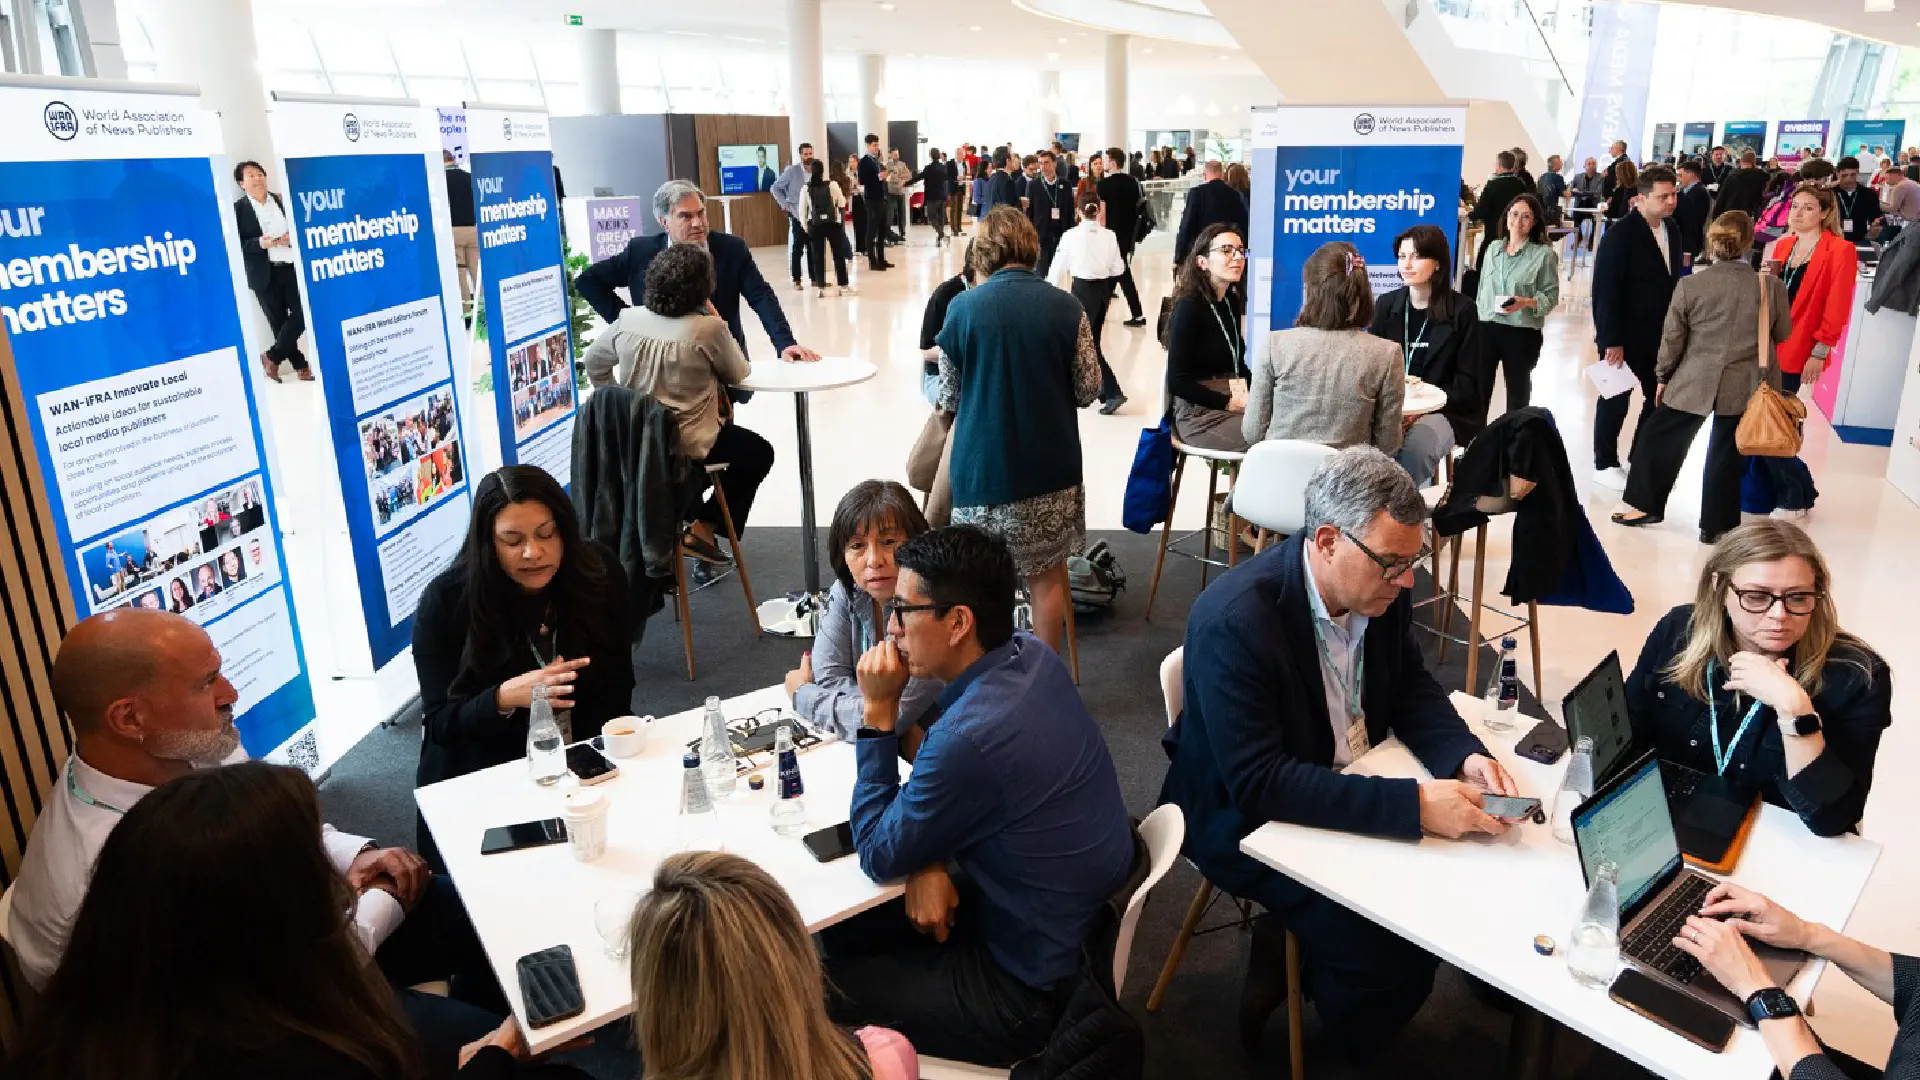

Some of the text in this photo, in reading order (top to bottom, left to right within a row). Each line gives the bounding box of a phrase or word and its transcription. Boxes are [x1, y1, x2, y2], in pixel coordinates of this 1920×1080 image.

[48, 111, 71, 121] WAN
[82, 109, 184, 122] World Association
[86, 124, 192, 136] of News Publishers
[477, 176, 504, 203] your
[1285, 168, 1340, 192] your
[298, 188, 346, 222] your
[480, 192, 547, 224] membership
[593, 206, 630, 220] MAKE
[1284, 188, 1435, 217] membership
[305, 207, 419, 249] membership
[482, 224, 527, 249] matters
[596, 230, 637, 243] GREAT
[597, 219, 630, 231] NEWS
[1284, 214, 1375, 234] matters
[0, 230, 196, 290] embership
[311, 248, 384, 282] matters
[49, 370, 188, 416] WAN-IFRA Innovate Local
[55, 387, 203, 436] Actionable ideas for sustainable
[58, 412, 167, 452] local media publishers
